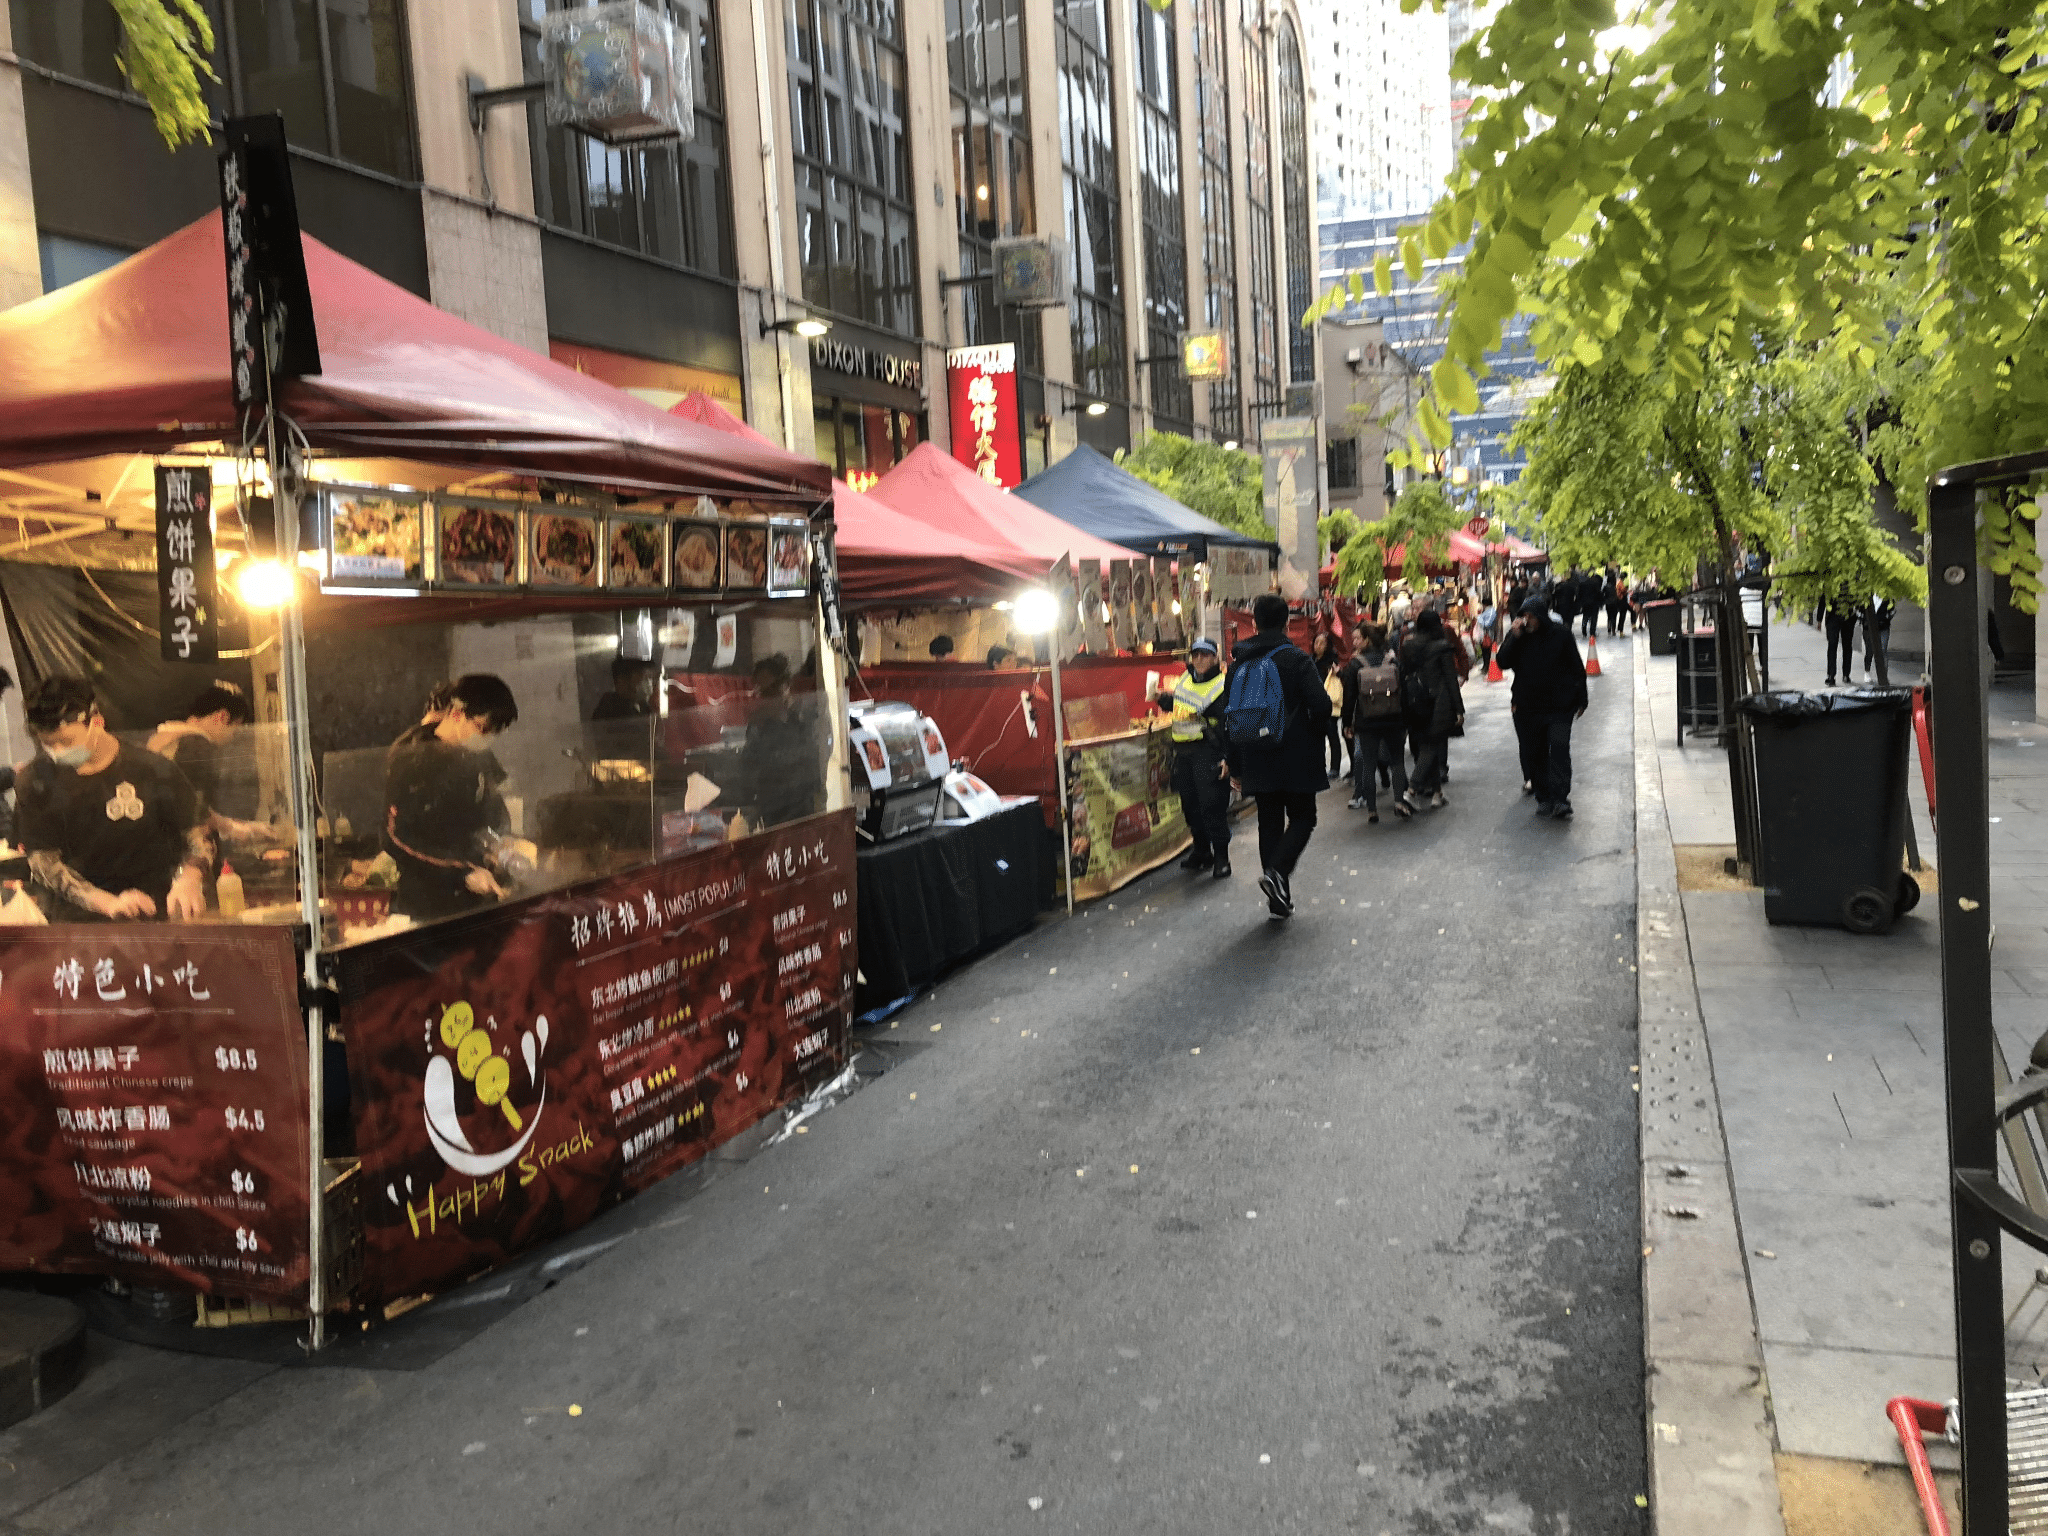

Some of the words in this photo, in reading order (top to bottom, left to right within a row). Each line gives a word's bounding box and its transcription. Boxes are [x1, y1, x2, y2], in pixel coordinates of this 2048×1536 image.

[815, 336, 867, 378] DIXON
[873, 350, 922, 390] HOUSE
[164, 468, 199, 659] 煎饼果子
[766, 838, 829, 881] 特色小吃
[53, 957, 211, 1001] 特色小吃
[43, 1045, 140, 1074] 煎饼果子
[48, 1075, 110, 1091] Traditional
[112, 1075, 159, 1088] Chinese
[56, 1105, 170, 1133] 风味炸香肠
[225, 1105, 265, 1133] $4.5
[231, 1168, 255, 1194] $6
[406, 1167, 505, 1240] Happy
[518, 1119, 594, 1187] Snack
[235, 1225, 258, 1253] $6
